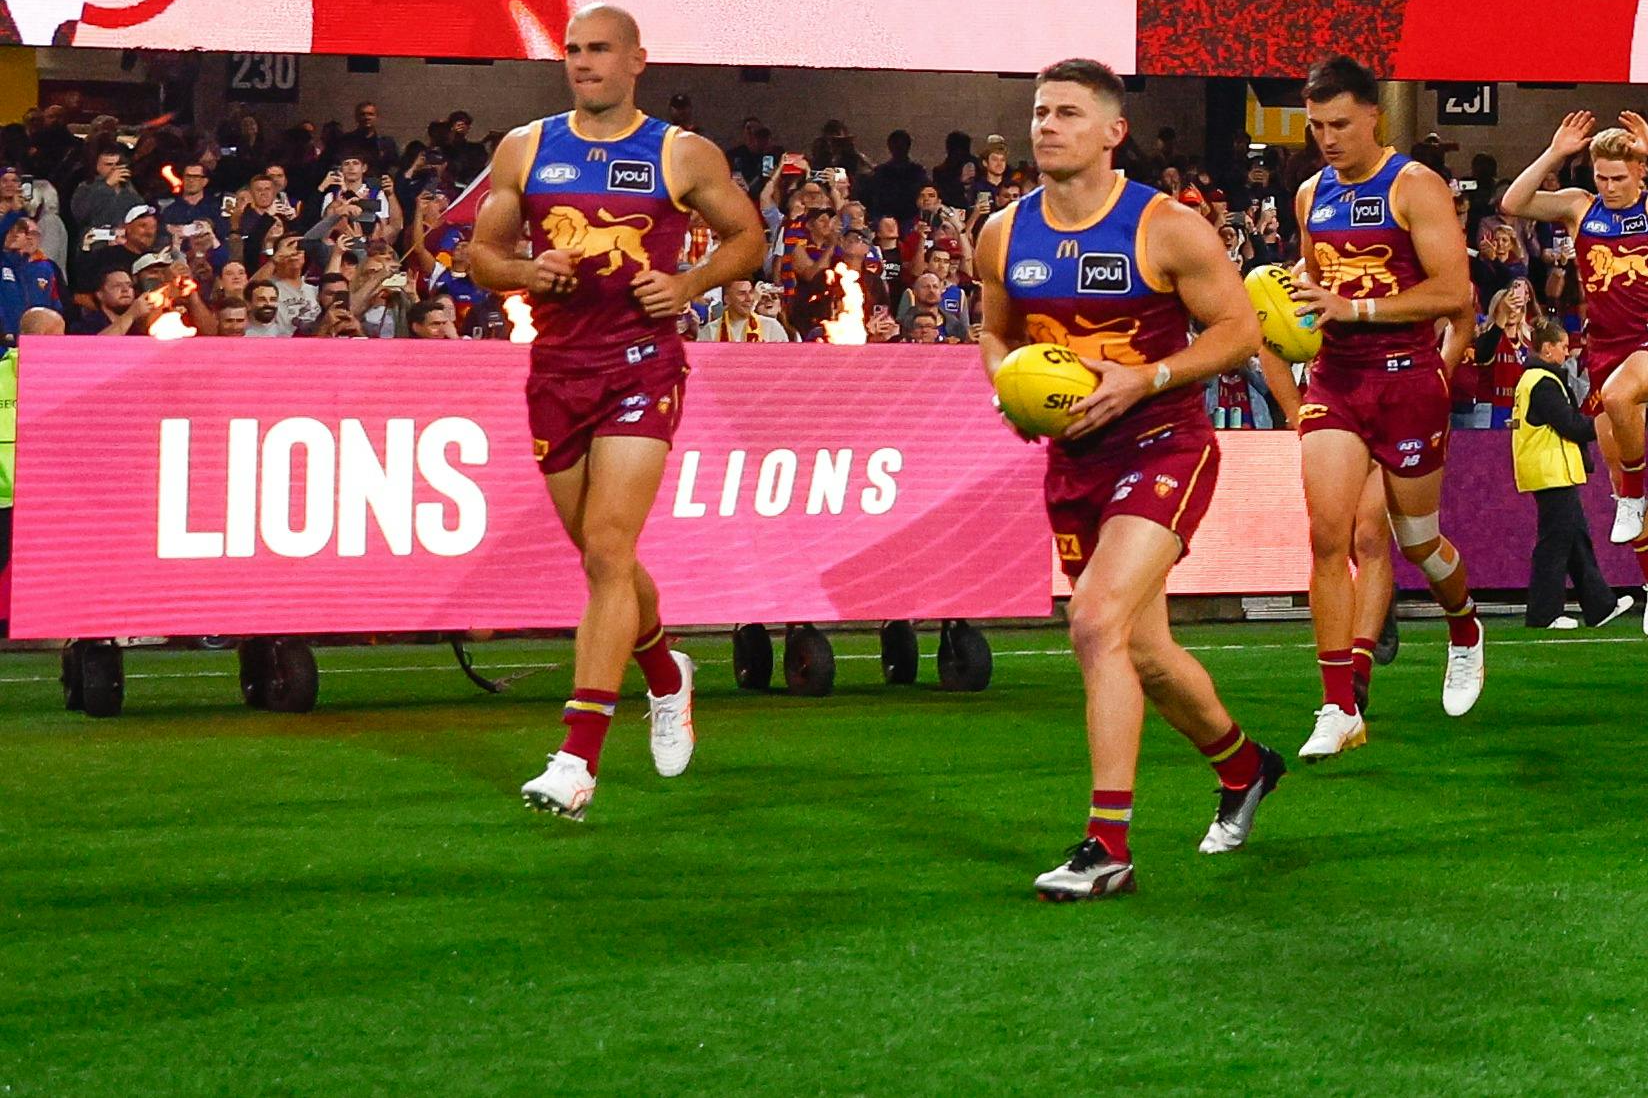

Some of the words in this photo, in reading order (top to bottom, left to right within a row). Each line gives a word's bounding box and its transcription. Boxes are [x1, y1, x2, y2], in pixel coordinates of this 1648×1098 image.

[231, 53, 296, 90] 230
[540, 166, 576, 180] AFL
[614, 167, 649, 185] youi
[1355, 201, 1380, 221] youi
[1012, 267, 1048, 281] AFL
[1085, 261, 1123, 286] youi
[1399, 441, 1422, 451] AFL
[156, 417, 489, 559] LIONS
[673, 448, 905, 519] LIONS
